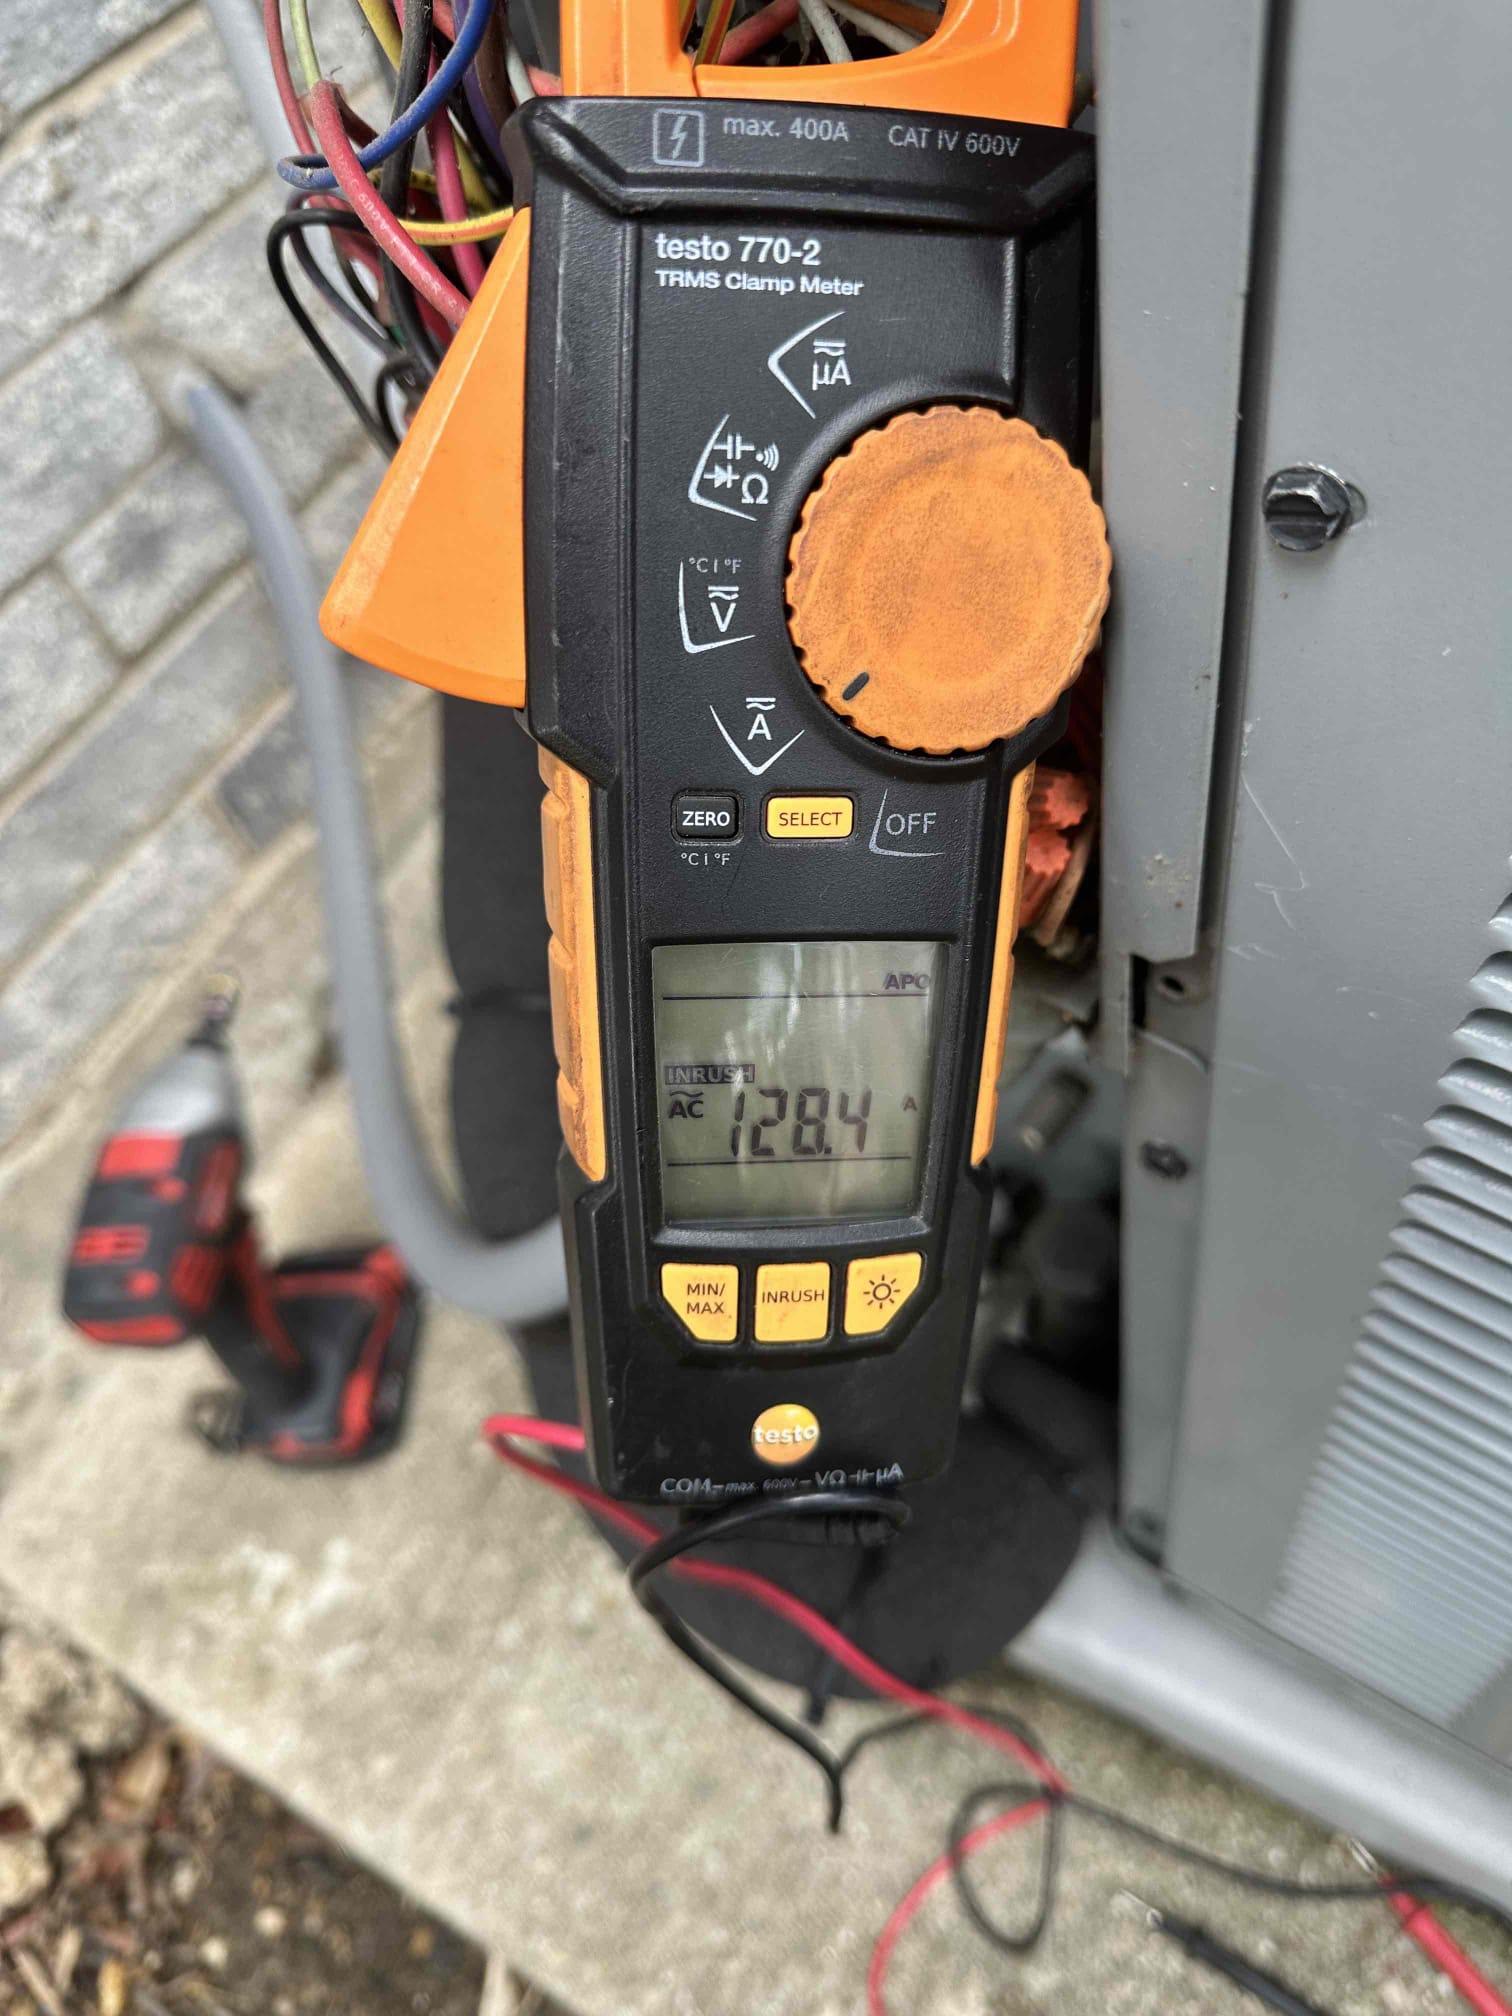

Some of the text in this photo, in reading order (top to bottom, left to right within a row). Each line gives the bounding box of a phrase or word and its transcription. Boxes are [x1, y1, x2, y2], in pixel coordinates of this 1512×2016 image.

[723, 116, 849, 142] max. 400A
[888, 124, 1021, 157] CAT IV 600V
[655, 232, 821, 266] testo 770-2
[655, 269, 865, 296] TRMS Clamp Meter
[710, 601, 737, 633] V
[747, 713, 773, 741] A
[682, 810, 731, 827] ZERO
[778, 811, 843, 827] SELECT
[885, 811, 937, 837] OFF
[666, 1065, 754, 1085] INRUSH
[667, 1099, 705, 1119] AC
[903, 1096, 919, 1112] A
[731, 1086, 873, 1157] 128.4
[686, 1282, 726, 1297] MIN/
[761, 1289, 826, 1304] INRUSH
[686, 1301, 725, 1315] MAX
[753, 1424, 819, 1444] testo
